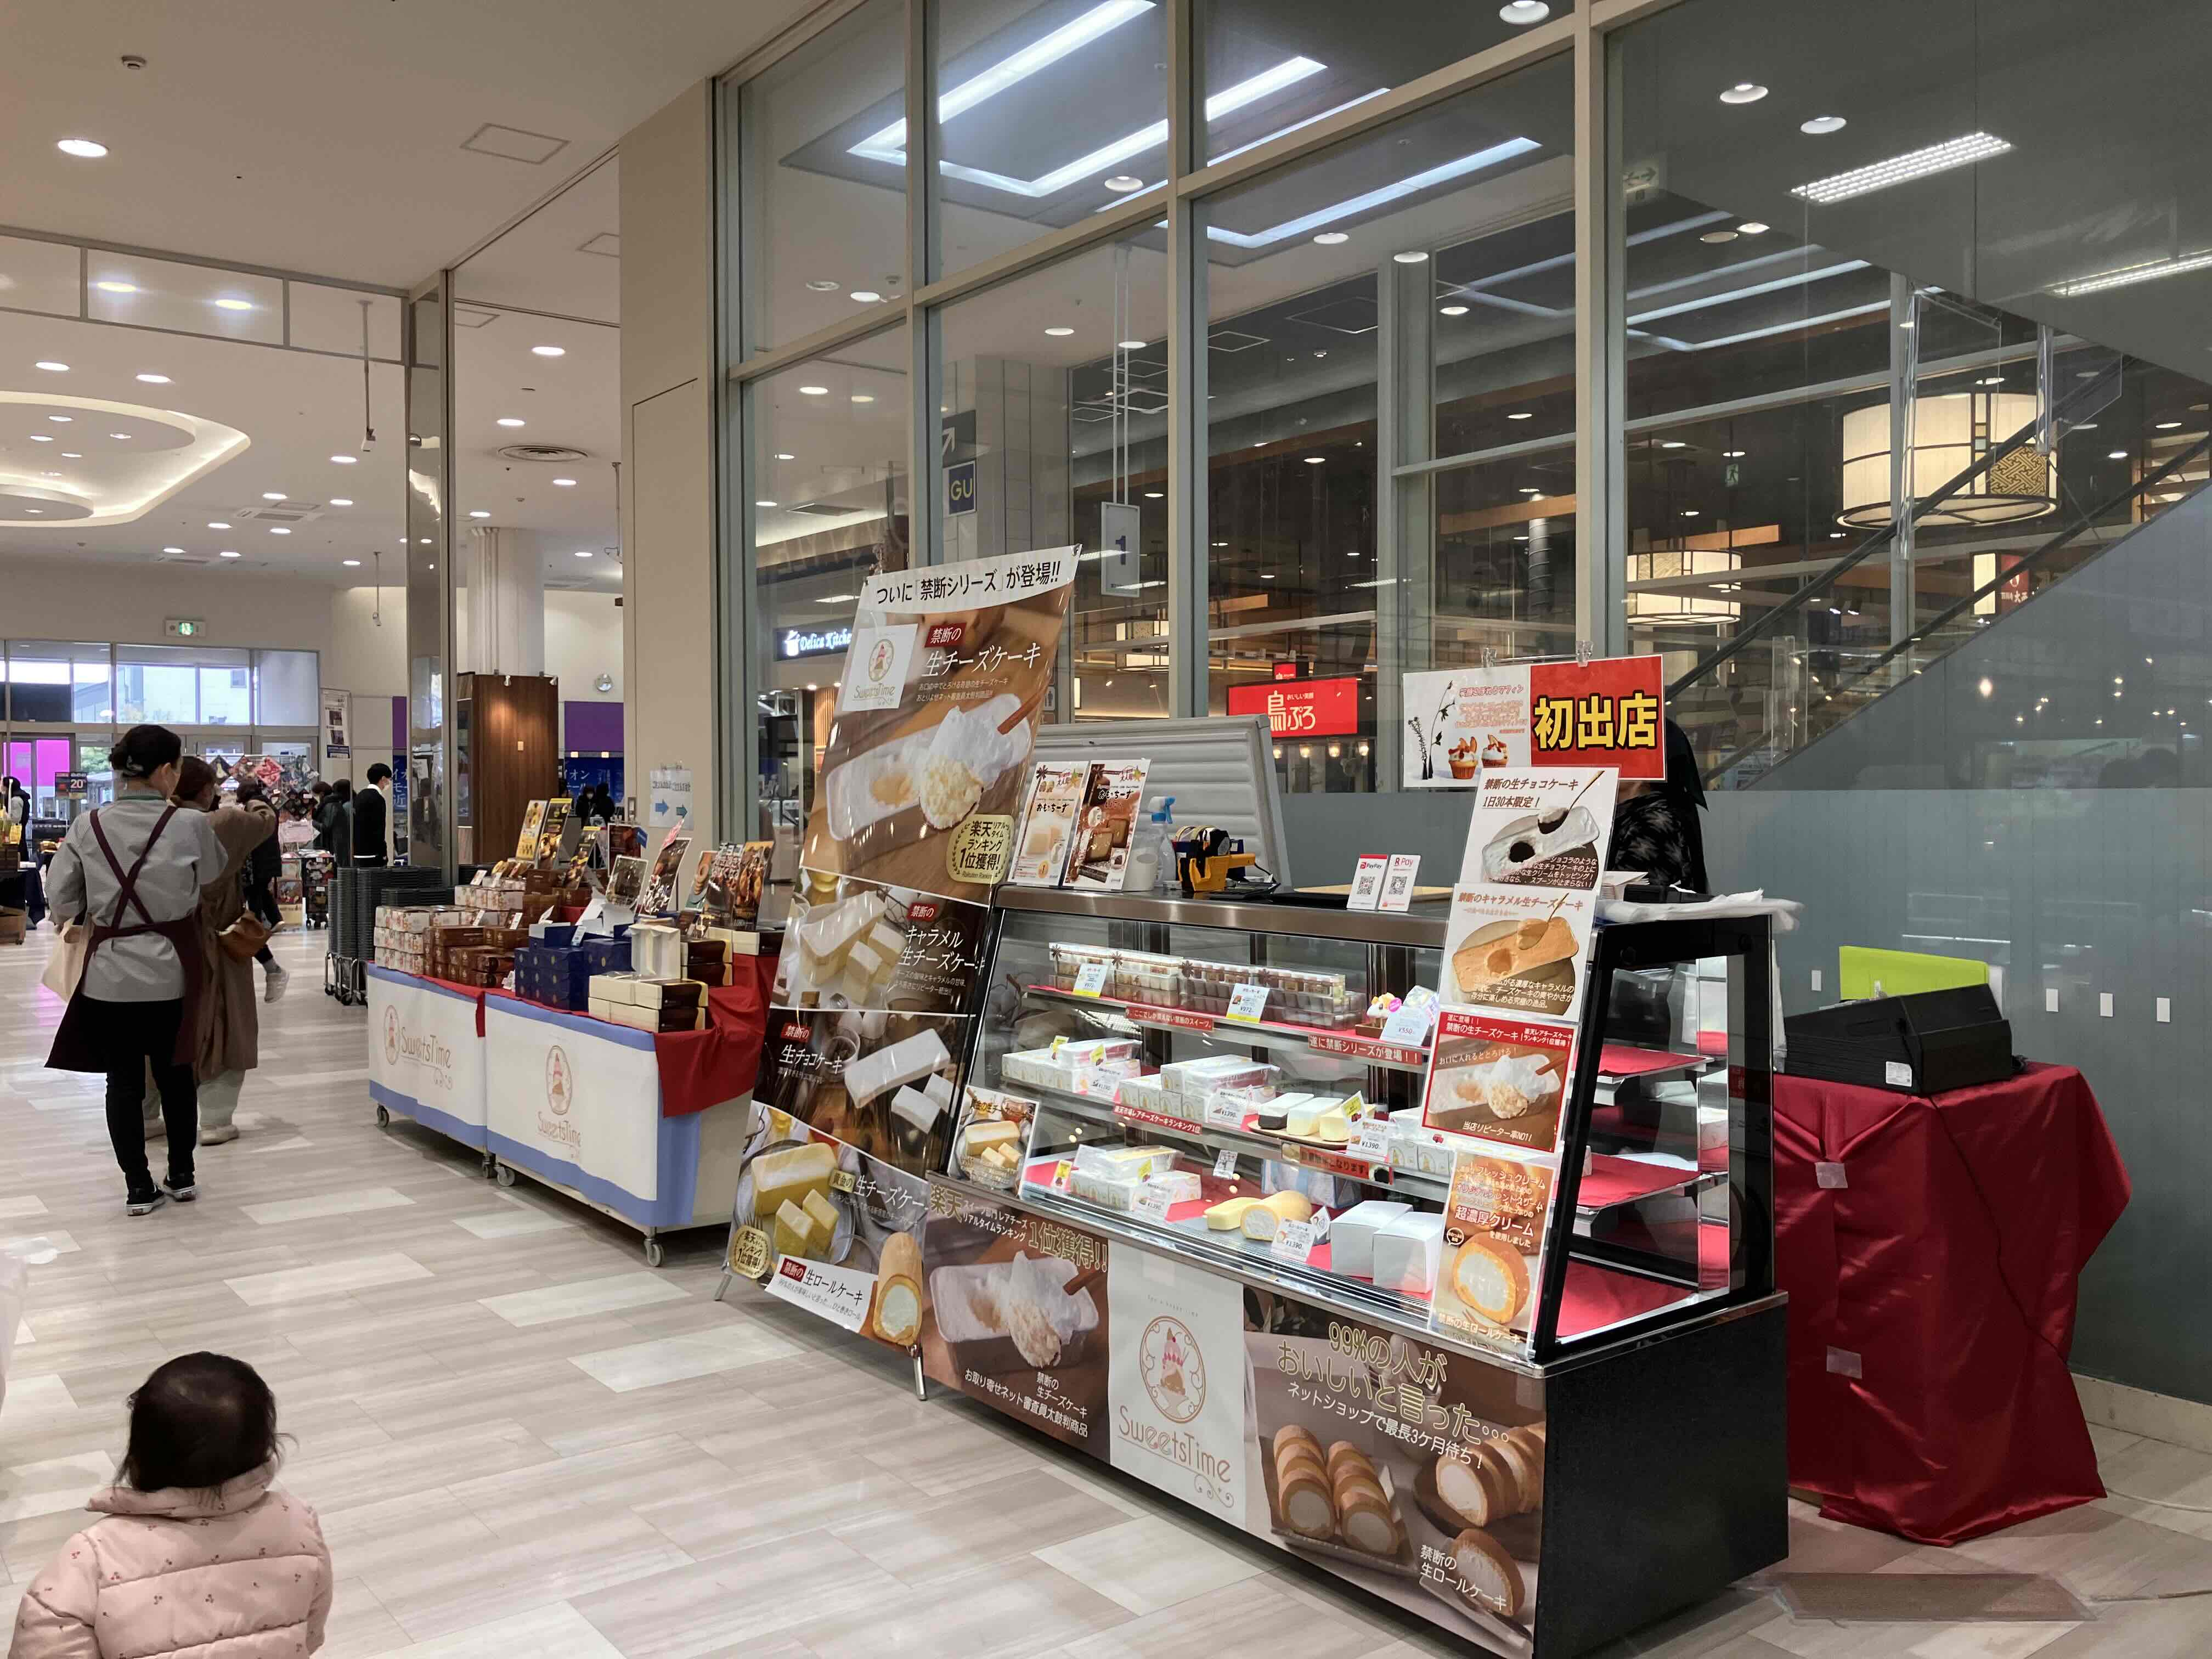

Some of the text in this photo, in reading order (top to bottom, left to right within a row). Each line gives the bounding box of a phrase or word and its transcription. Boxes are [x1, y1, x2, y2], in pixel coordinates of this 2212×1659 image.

[950, 478, 973, 501] GU
[1115, 535, 1127, 566] 1
[800, 628, 852, 651] Delica Kitche
[930, 627, 962, 644] 禁断の
[921, 642, 1041, 677] 生チーズケーキ
[1267, 690, 1317, 731] 鳥ぷろ
[1533, 690, 1658, 751] 初出店
[1483, 778, 1579, 791] 禁断の生チョコケーキ
[1483, 796, 1541, 808] 1日30本限定！
[970, 820, 993, 837] 楽天
[968, 839, 1003, 852] ランキング
[960, 847, 1001, 871] 1位獲得!
[1401, 858, 1414, 867] Pay
[911, 905, 934, 918] 禁断の
[1457, 891, 1584, 911] 禁断のキャラメル生チーズケーキ
[905, 925, 964, 948] キャラメル
[785, 1025, 809, 1039] 禁断の
[1445, 1022, 1519, 1041] 禁断の生チーズケーキ
[401, 1026, 452, 1069] SweetsTime
[779, 1044, 843, 1075] 生チョコケーキ
[854, 1175, 929, 1210] 生チーズケー
[929, 1184, 963, 1223] 楽天
[962, 1212, 1027, 1242] リアルタイムランキング
[1455, 1205, 1534, 1237] 超濃厚クリーム
[743, 1231, 757, 1245] 楽天
[1028, 1221, 1108, 1273] 1位獲得!!
[783, 1261, 804, 1278] 禁断の
[803, 1269, 864, 1306] 生ロールケーキ
[1329, 1322, 1447, 1389] 99%の人が
[1036, 1372, 1059, 1390] 禁断の
[964, 1368, 1088, 1438] お取り寄せネット審査員太鼓判商品
[1036, 1386, 1088, 1420] 生チーズケーキ
[1118, 1405, 1231, 1483] SweetsTime
[1420, 1544, 1457, 1570] 禁断の
[1420, 1562, 1508, 1612] 生ロールケーキ
